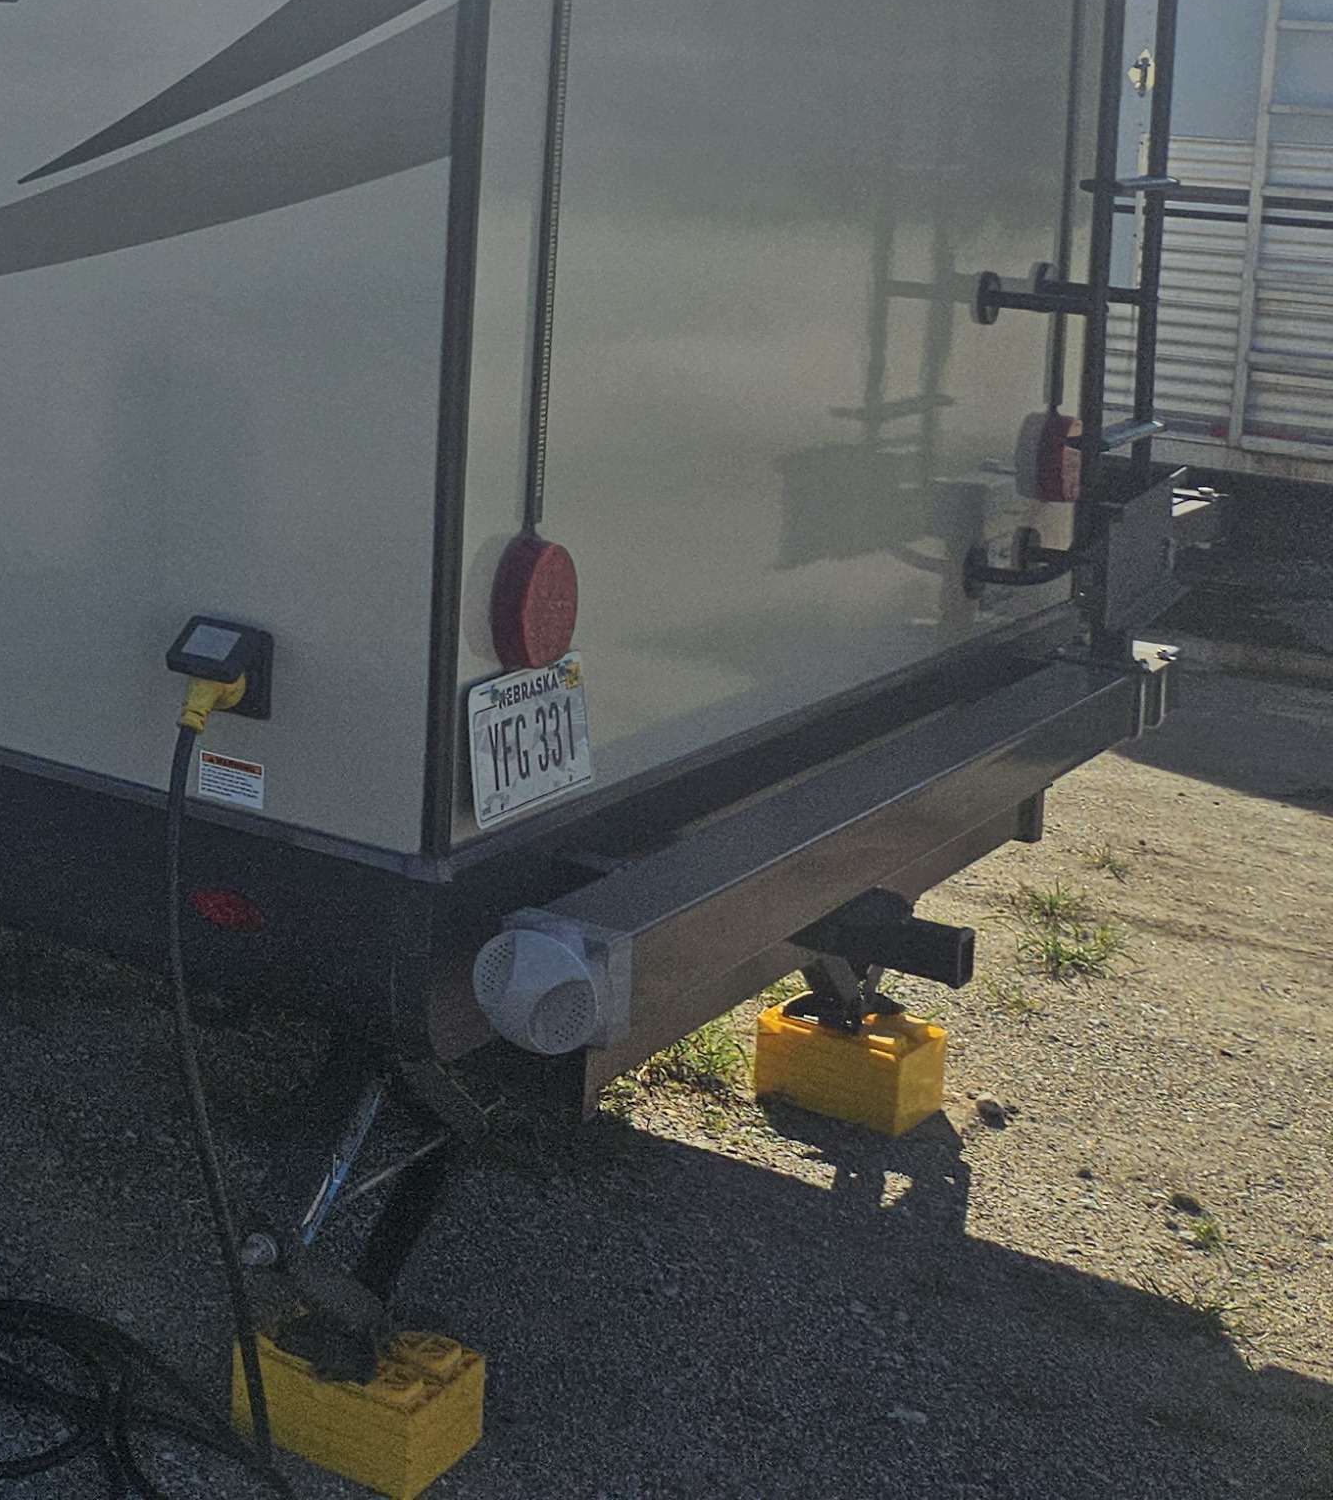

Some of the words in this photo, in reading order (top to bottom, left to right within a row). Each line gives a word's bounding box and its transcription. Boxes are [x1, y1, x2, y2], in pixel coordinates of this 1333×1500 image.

[497, 670, 559, 710] NEBRASKA
[487, 713, 531, 791] YFG
[535, 697, 575, 772] 331
